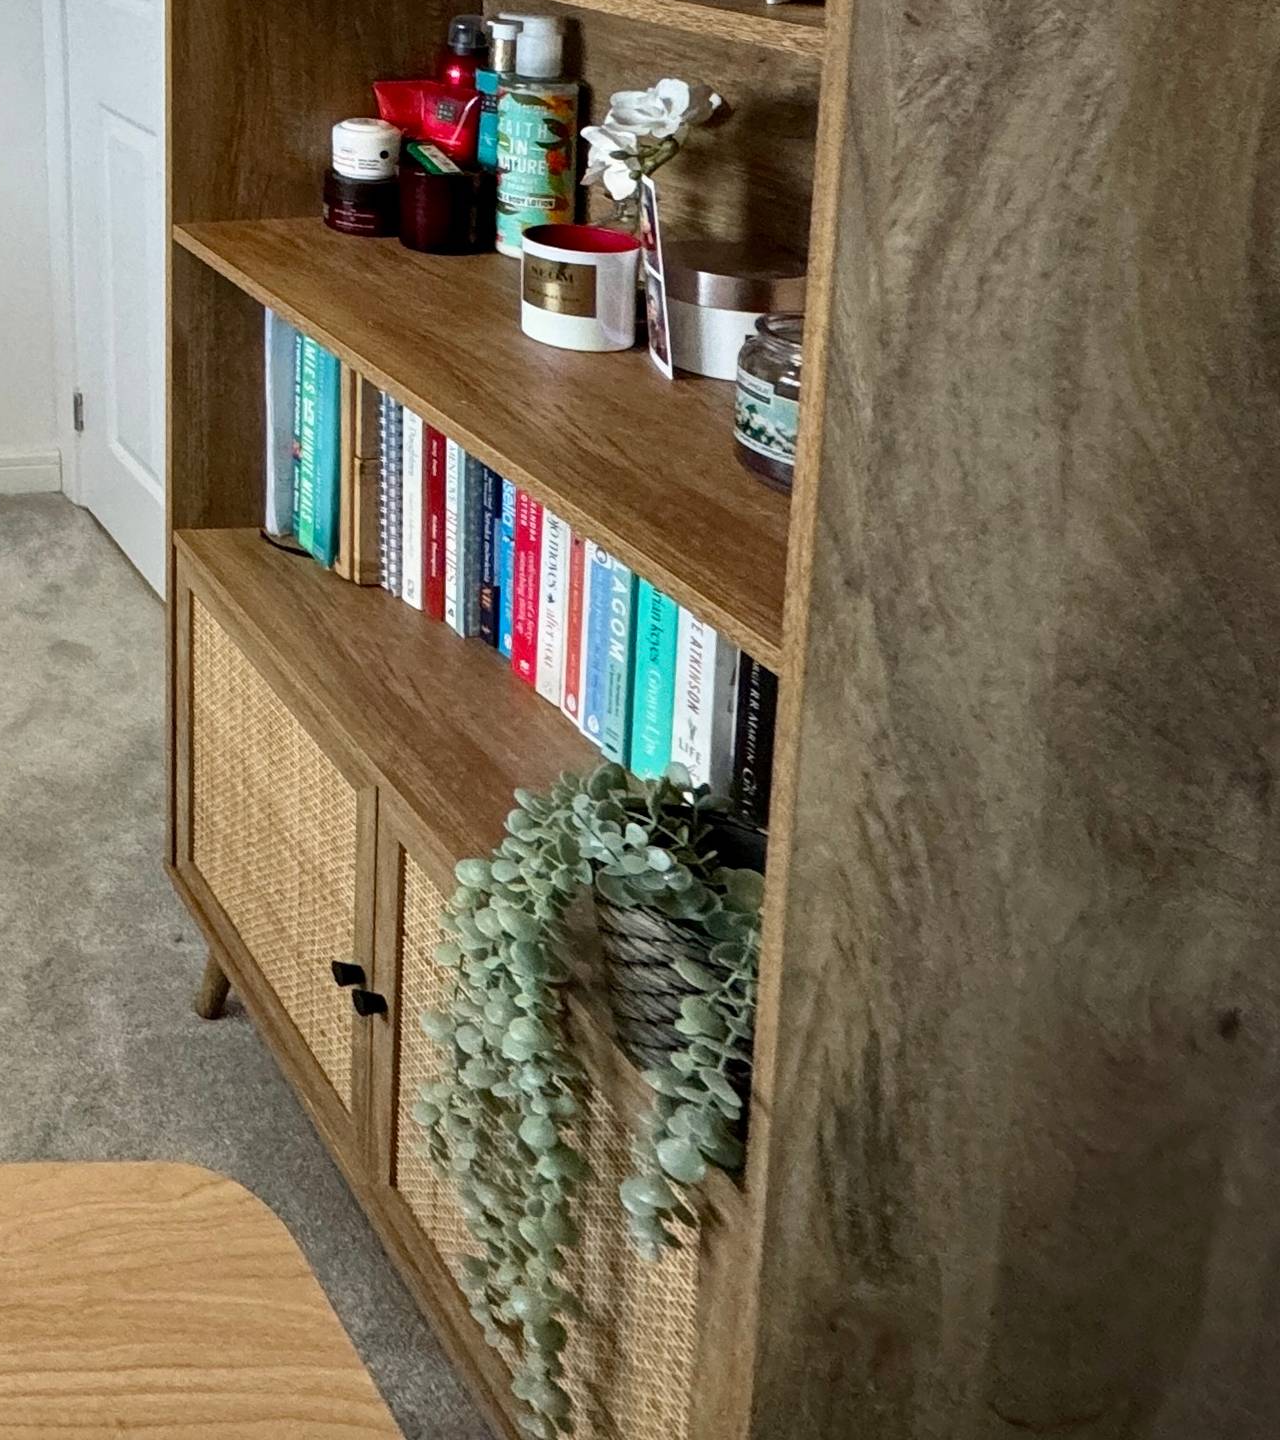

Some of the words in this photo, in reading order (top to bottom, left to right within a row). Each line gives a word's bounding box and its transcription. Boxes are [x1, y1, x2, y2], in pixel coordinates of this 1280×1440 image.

[509, 140, 528, 155] IN
[608, 560, 629, 664] LAGOM
[687, 637, 703, 715] ATKINSON
